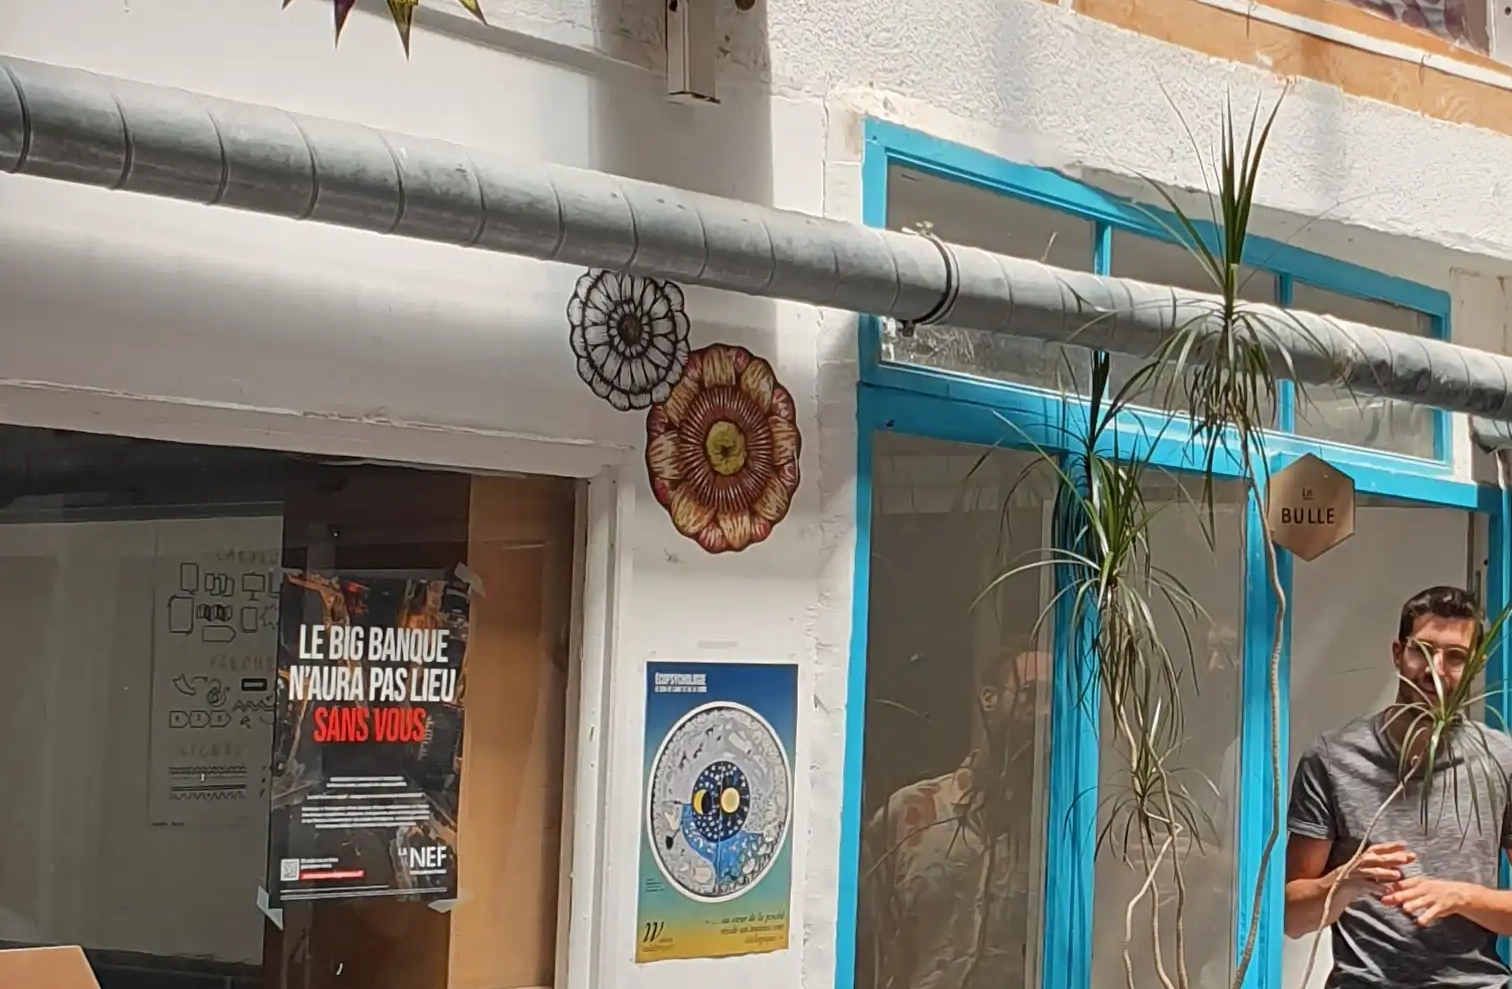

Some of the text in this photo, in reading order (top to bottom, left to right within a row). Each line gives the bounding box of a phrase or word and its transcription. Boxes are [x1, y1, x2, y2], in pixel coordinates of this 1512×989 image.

[1281, 507, 1336, 525] BULLE
[299, 624, 450, 665] LE BIG BANQUE
[288, 665, 457, 703] N'AURA PAS LIEU
[313, 706, 426, 743] SANS VOUS
[409, 846, 447, 868] NEF
